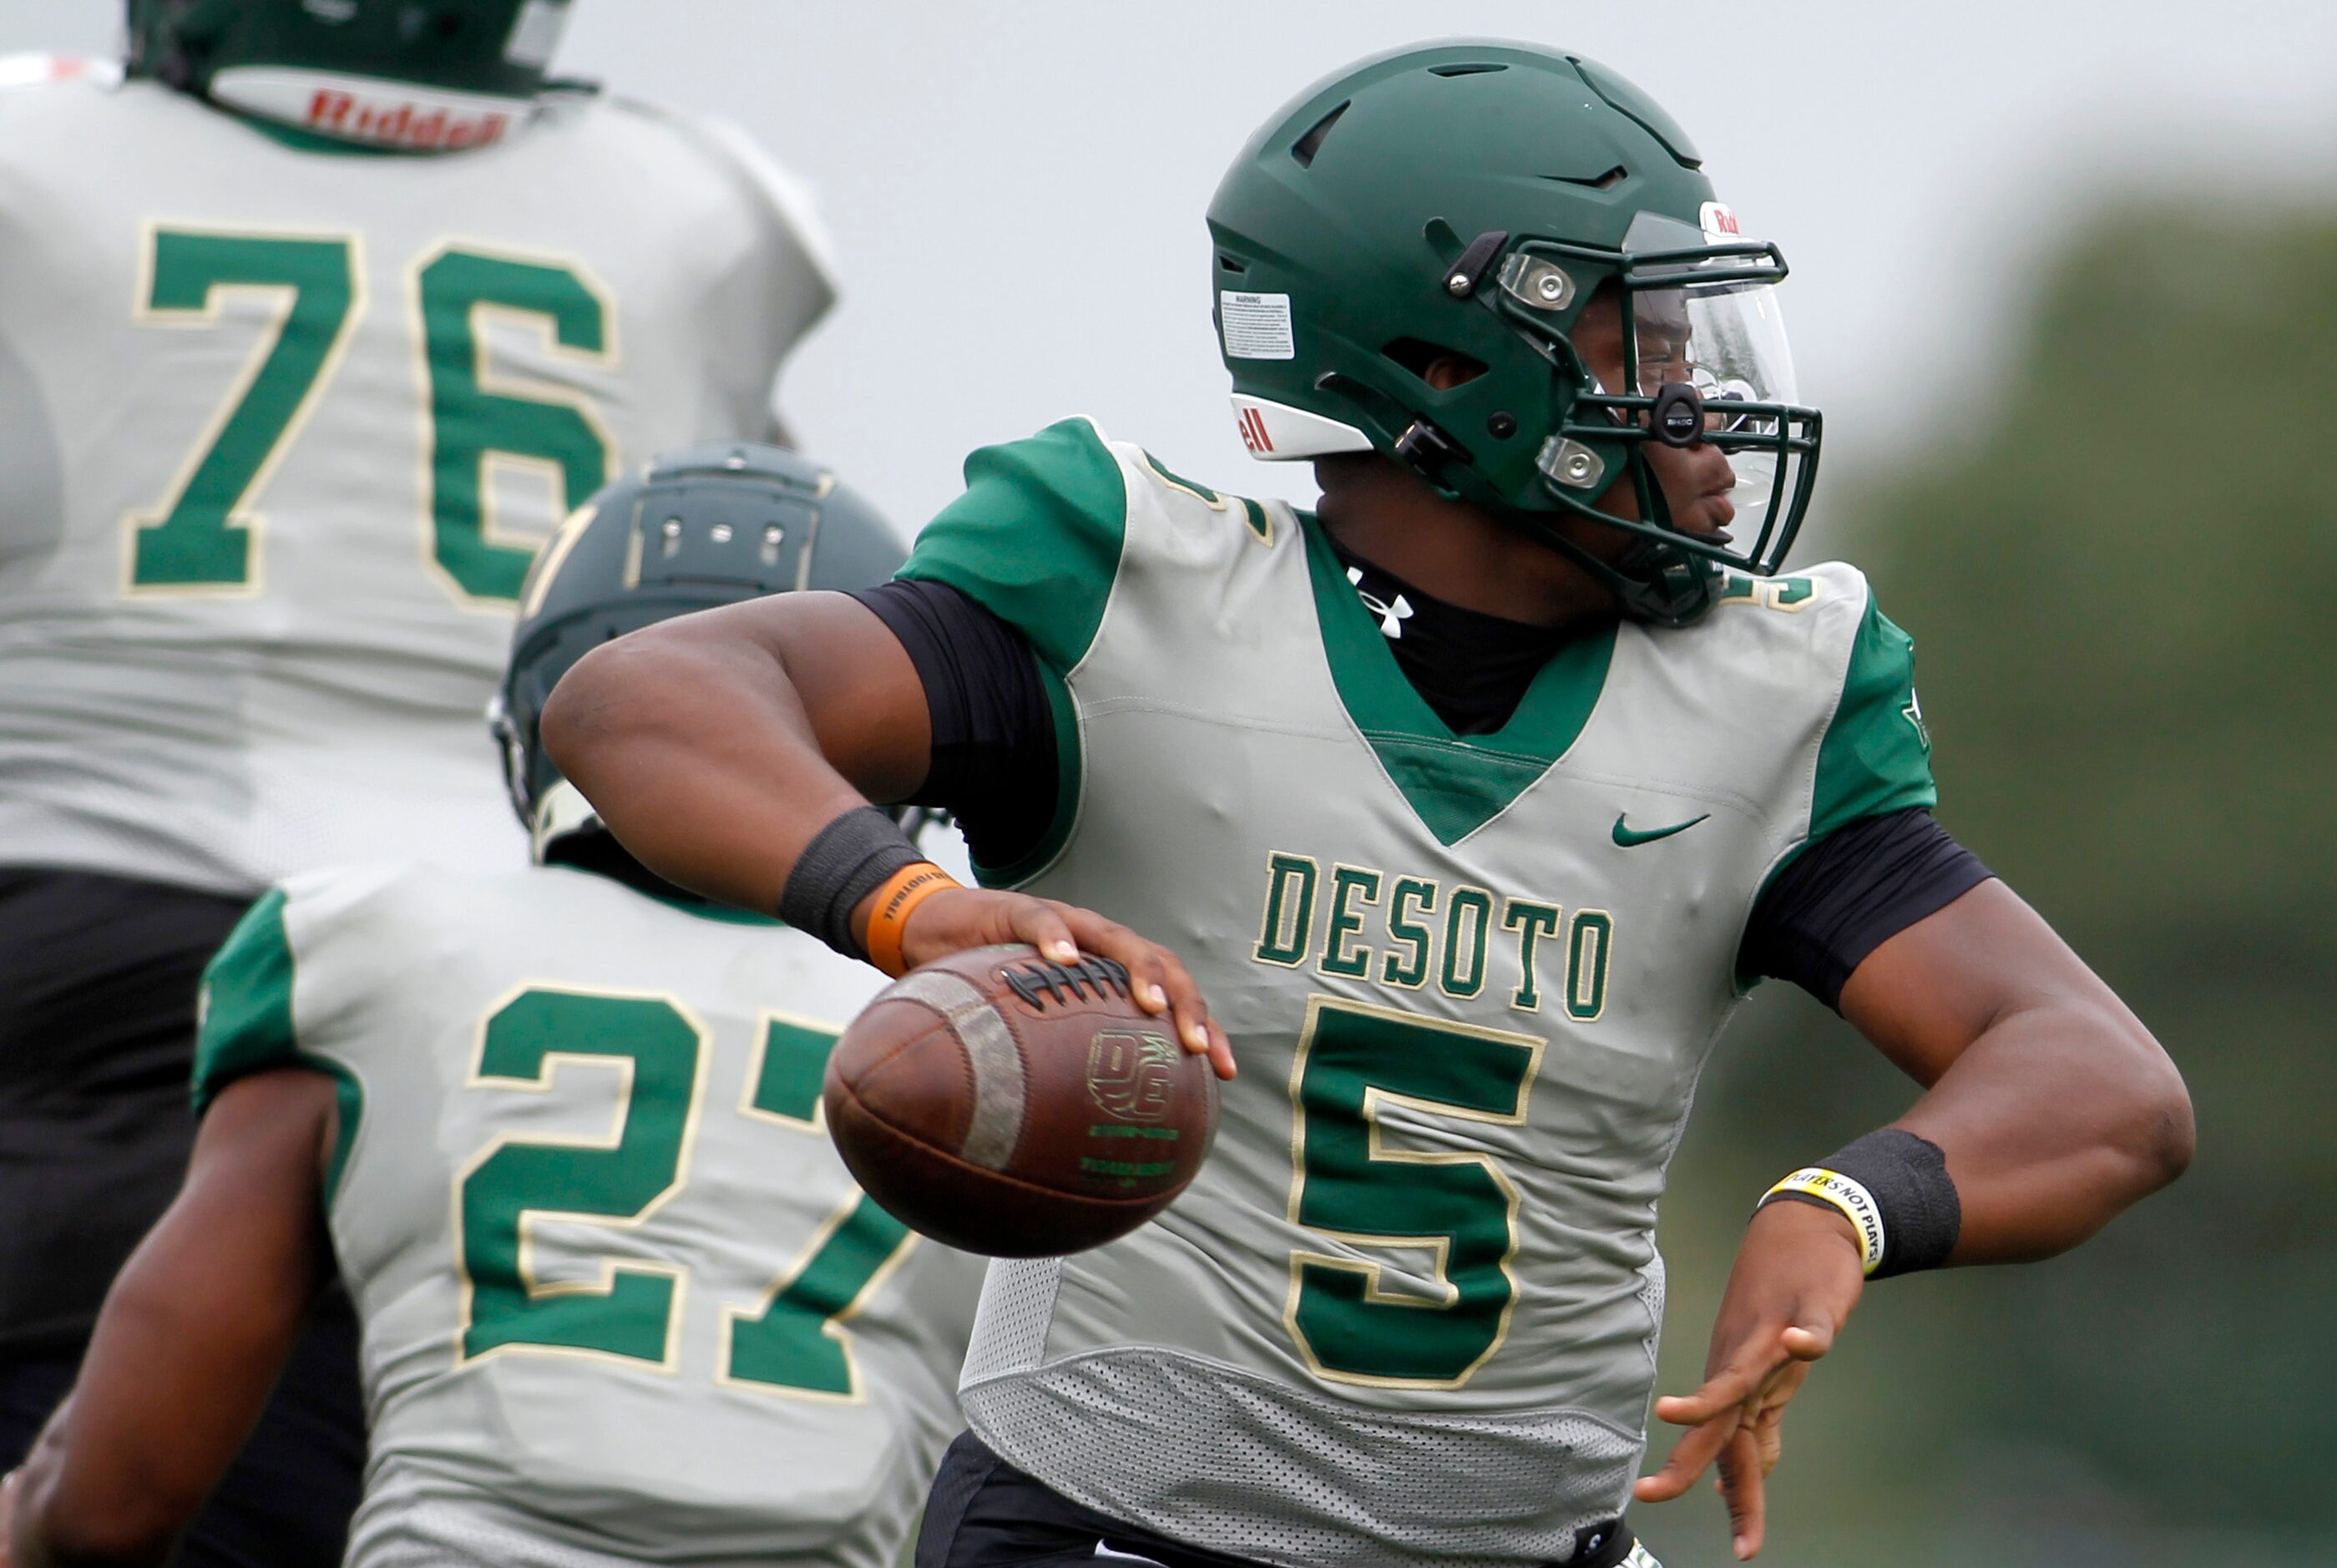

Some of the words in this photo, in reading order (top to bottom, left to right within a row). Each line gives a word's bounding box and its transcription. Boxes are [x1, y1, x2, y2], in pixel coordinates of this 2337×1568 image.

[121, 219, 620, 615] 76
[1236, 296, 1261, 304] WARNING
[1252, 850, 1615, 1022] DESOTO
[448, 979, 921, 1404] 27
[1282, 992, 1548, 1390] 5
[1784, 1172, 1844, 1191] PLAYERS
[1839, 1186, 1869, 1212] NOT
